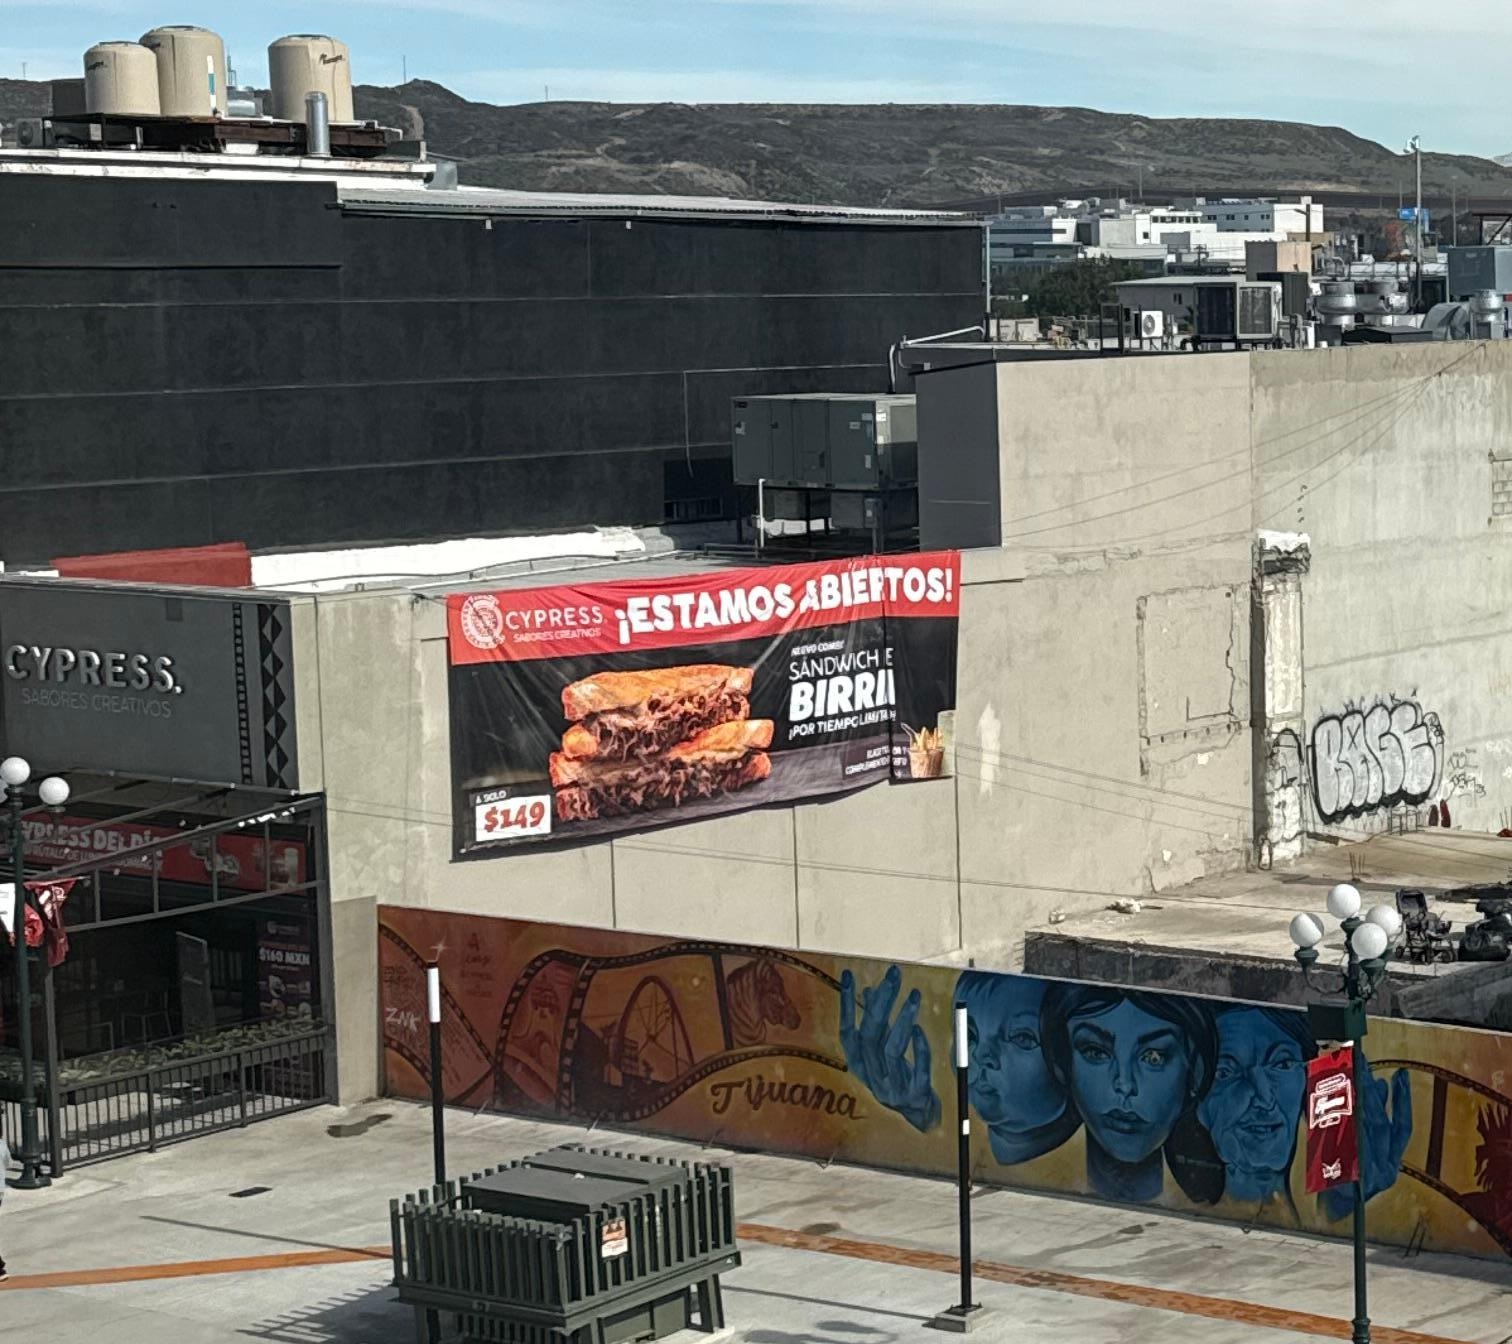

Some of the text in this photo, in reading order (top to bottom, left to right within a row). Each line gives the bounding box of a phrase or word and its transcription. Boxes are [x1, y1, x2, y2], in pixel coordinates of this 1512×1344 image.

[618, 567, 953, 644] ¡ESTAMOS ABIERTOS!
[22, 688, 173, 718] SABORES CREATIVOS
[484, 802, 545, 832] $149
